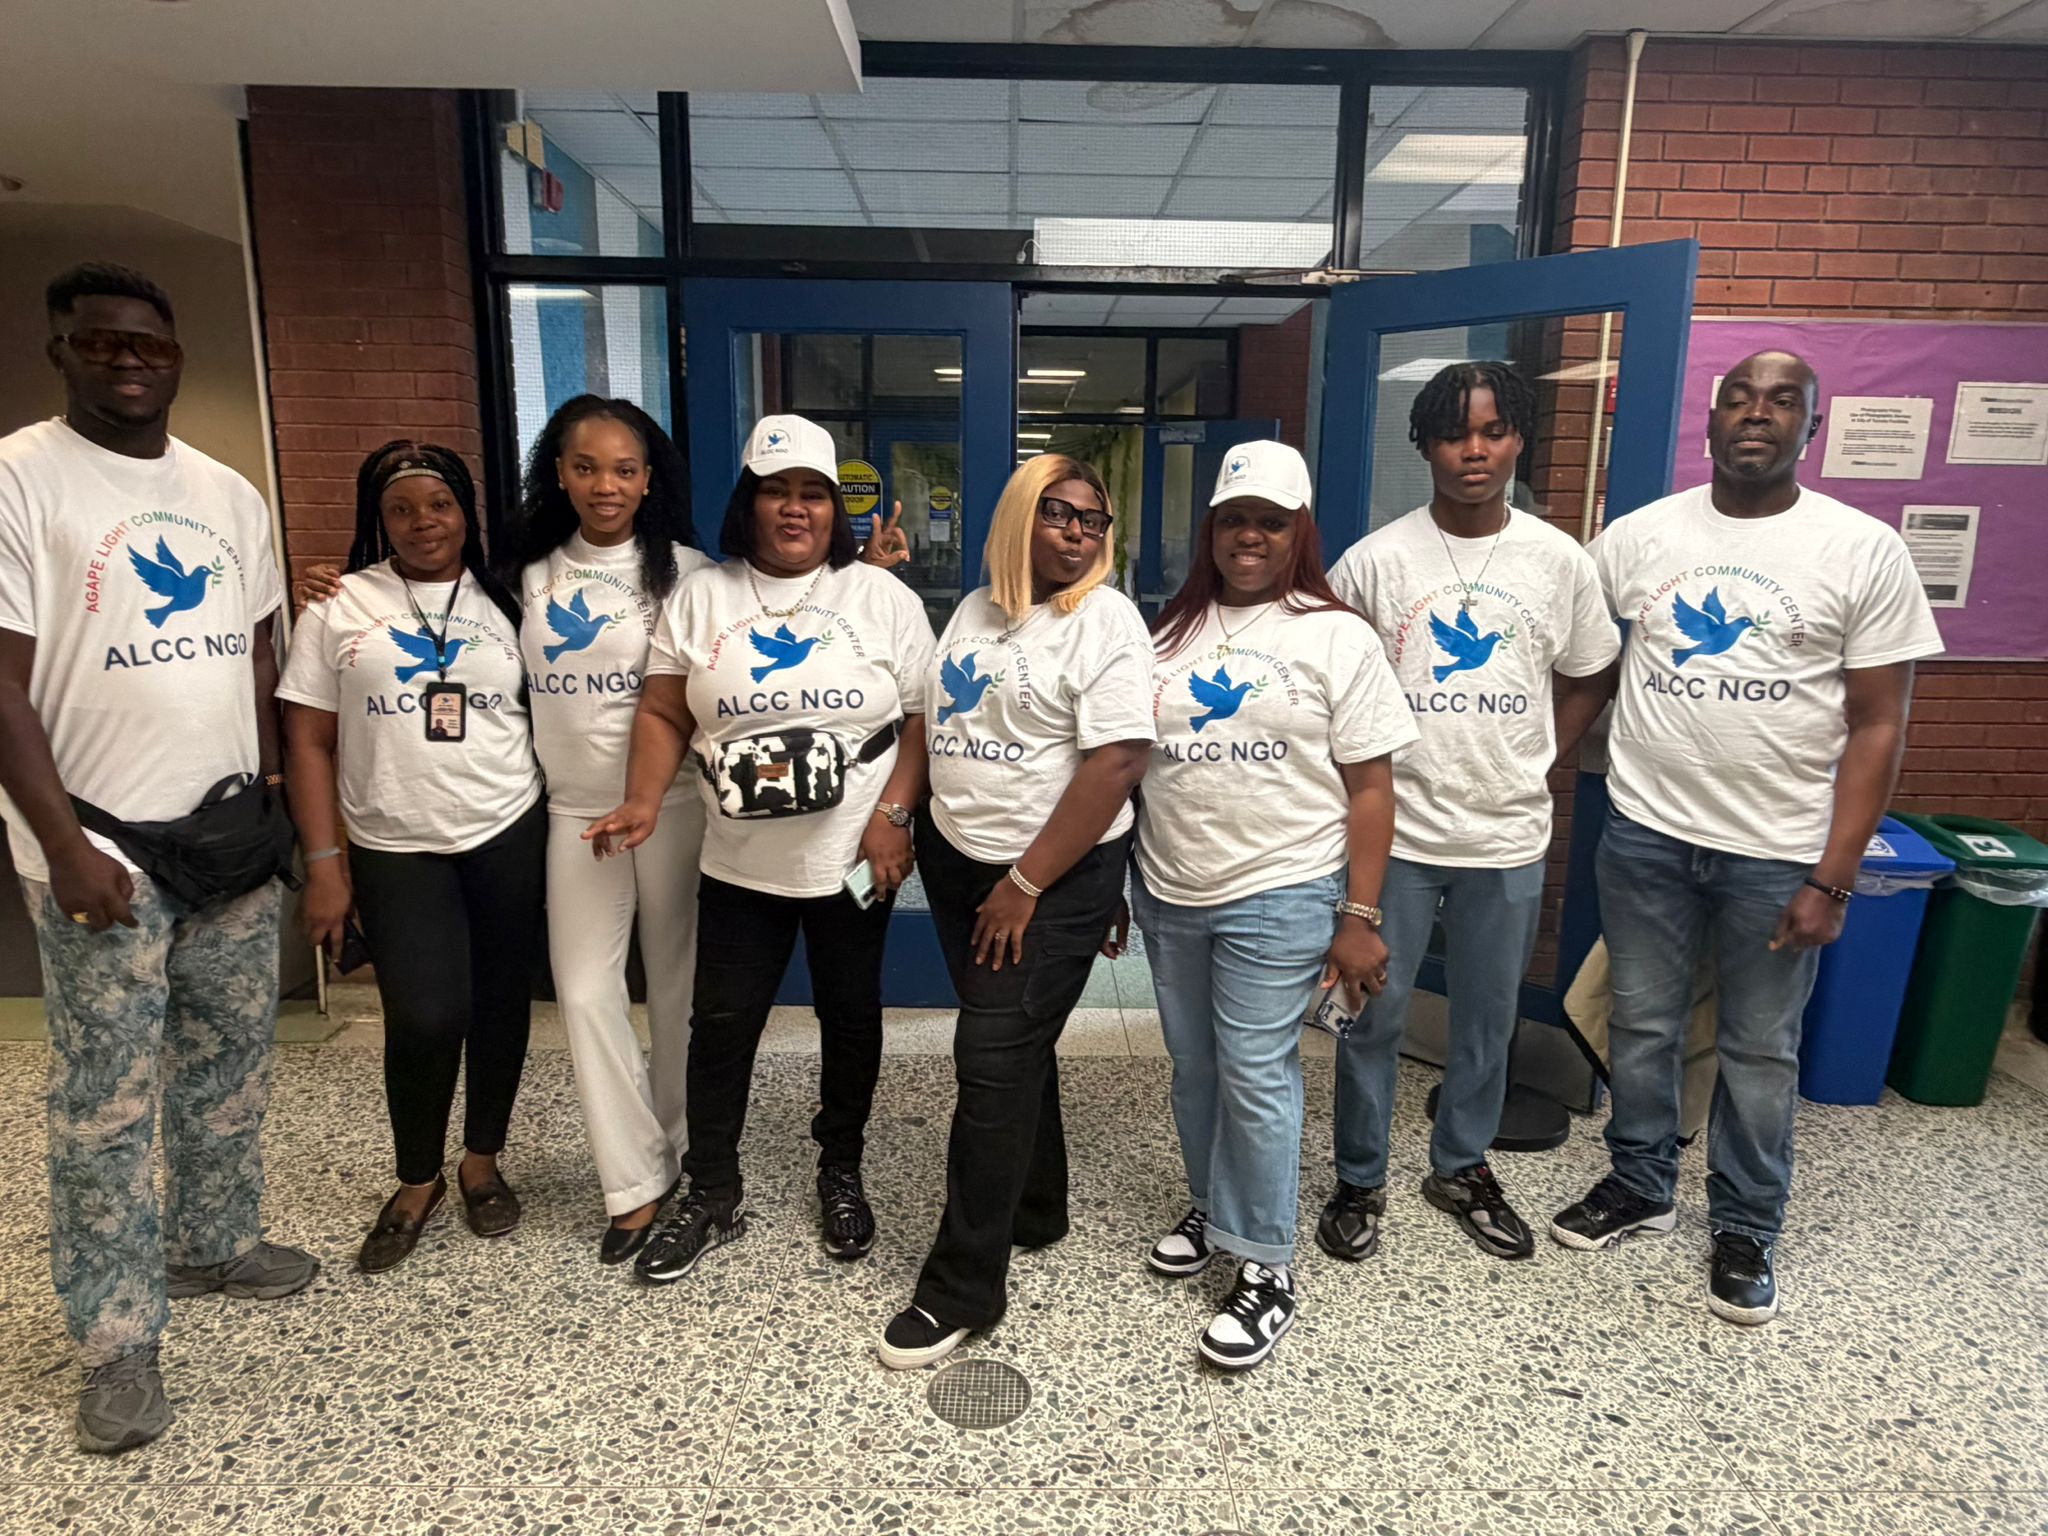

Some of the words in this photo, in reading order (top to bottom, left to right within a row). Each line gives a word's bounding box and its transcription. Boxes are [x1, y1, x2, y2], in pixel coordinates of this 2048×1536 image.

[841, 484, 876, 493] AUTION
[95, 520, 131, 558] LIGHT
[131, 511, 217, 539] COMMUNITY
[85, 559, 106, 614] AGAPE
[566, 568, 638, 599] COMMUNITY
[1406, 589, 1439, 620] LIGHT
[1443, 582, 1522, 609] COMMUNITY
[1649, 570, 1688, 602] LIGHT
[1694, 565, 1784, 594] COMMUNITY
[1779, 596, 1805, 648] CENTER
[104, 638, 196, 671] ALCC
[204, 633, 248, 657] NGO
[706, 632, 728, 671] AGAPE
[726, 613, 761, 633] LIGHT
[836, 617, 866, 658] CENTER
[587, 671, 642, 694] NGO
[1016, 656, 1031, 711] CENTER
[1273, 661, 1300, 707] CENTER
[1643, 671, 1705, 699] ALCC
[1718, 679, 1791, 701] NGO
[717, 690, 790, 719] ALCC
[801, 688, 864, 710] NGO
[1478, 693, 1527, 714] NGO
[929, 734, 959, 757] CC
[963, 738, 1025, 762] NGO
[1164, 741, 1221, 763] ALCC
[1231, 740, 1288, 762] NGO
